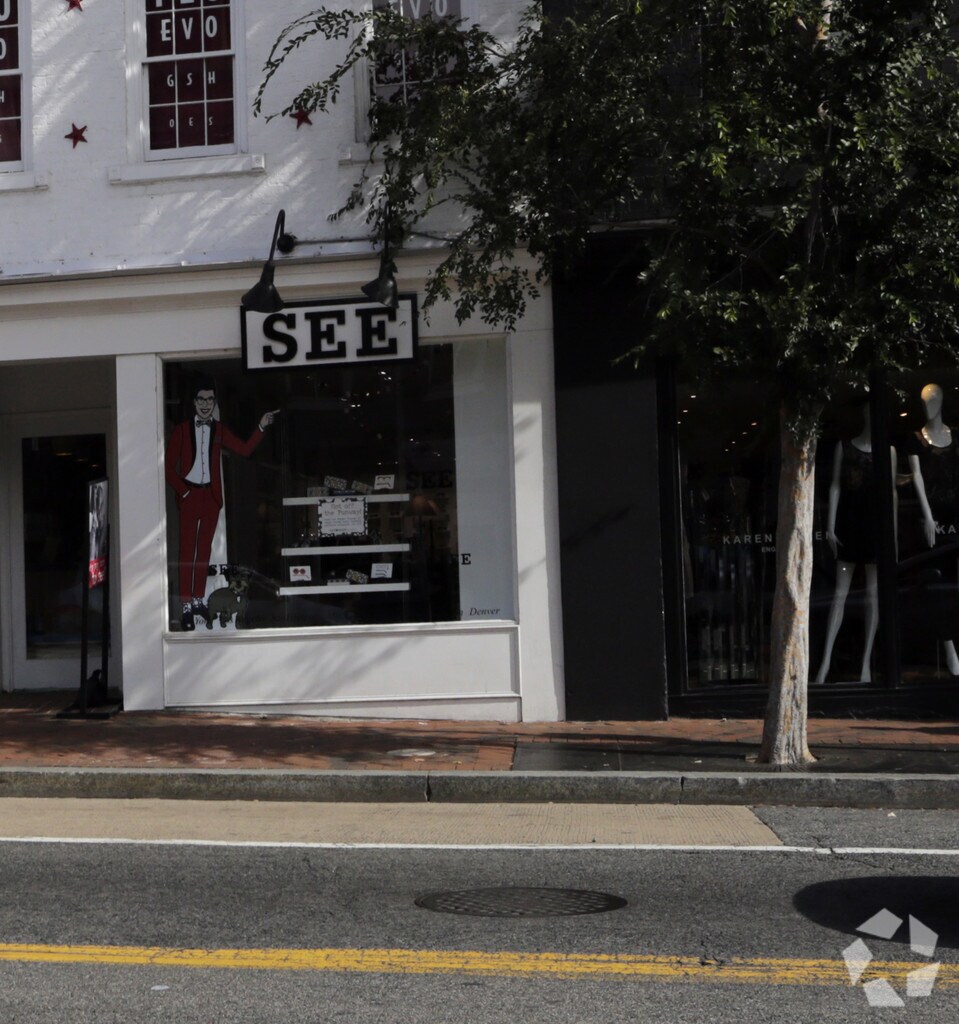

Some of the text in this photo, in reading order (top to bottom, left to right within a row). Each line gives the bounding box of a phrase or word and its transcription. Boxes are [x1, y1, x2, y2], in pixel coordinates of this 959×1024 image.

[160, 15, 218, 42] EVO
[262, 307, 398, 363] SEE
[723, 534, 773, 545] KAREN
[469, 607, 500, 617] Denver
